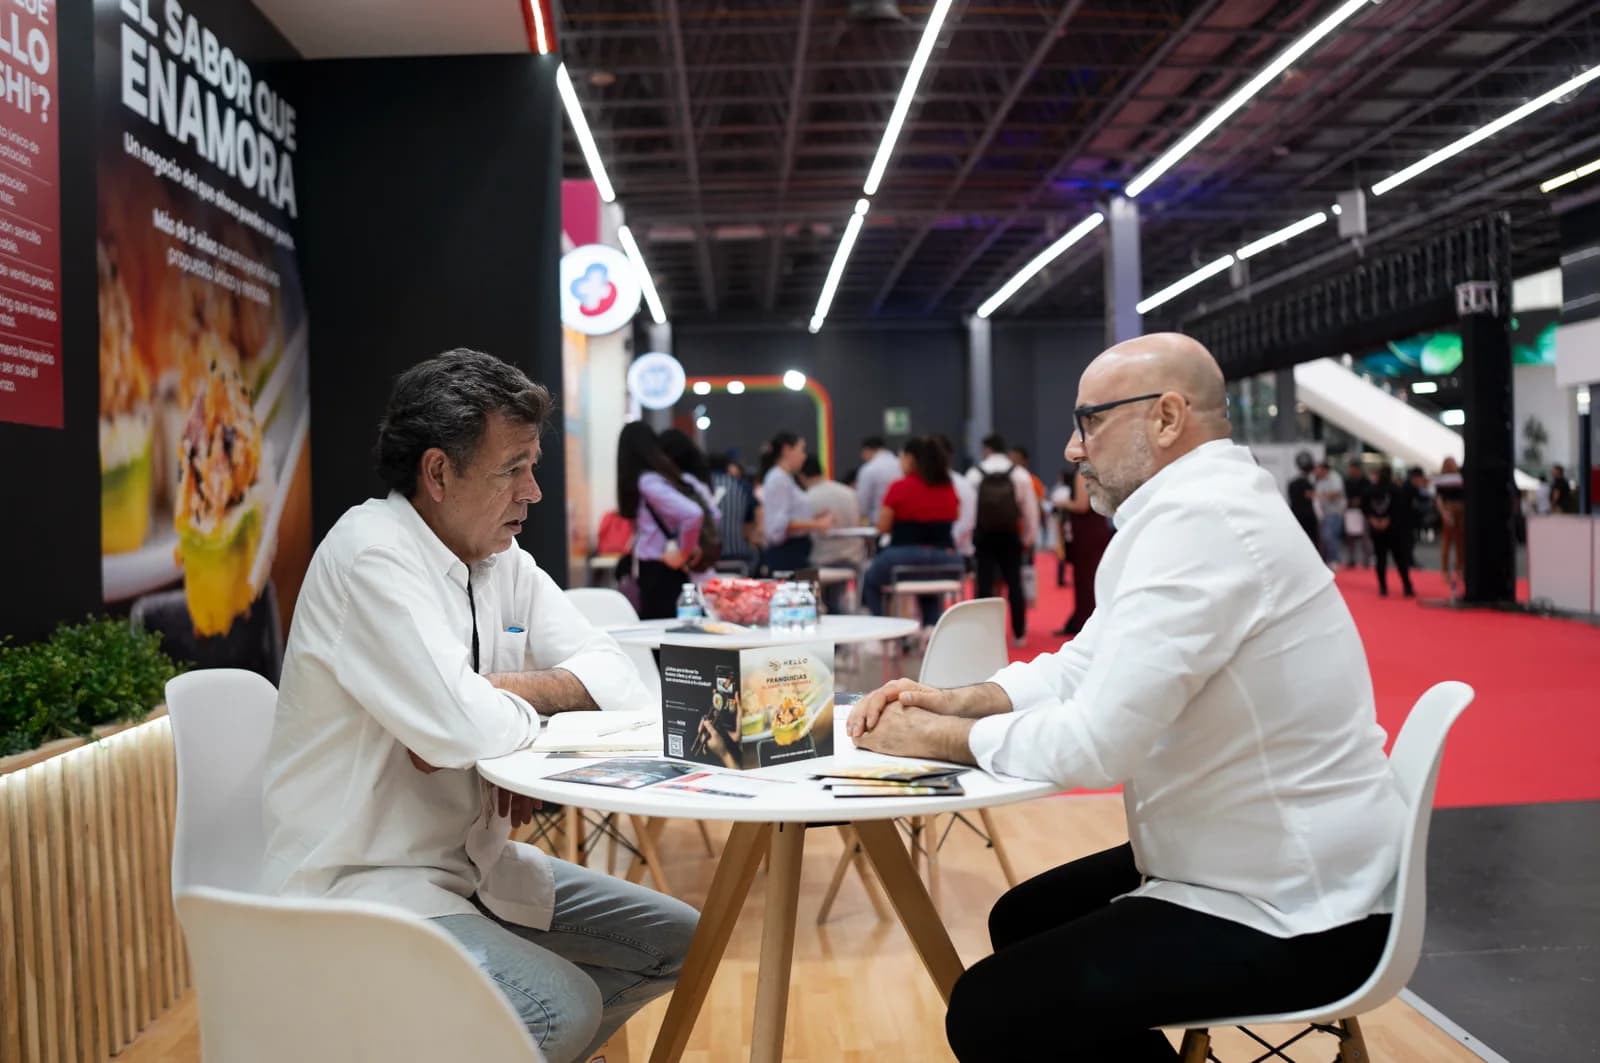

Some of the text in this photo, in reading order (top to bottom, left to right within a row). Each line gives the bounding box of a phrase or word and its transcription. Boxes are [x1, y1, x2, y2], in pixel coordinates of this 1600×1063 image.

[121, 23, 298, 218] ENAMORA
[164, 0, 253, 117] SABOR
[255, 80, 298, 152] QUE
[123, 131, 141, 159] Un
[141, 146, 183, 183] negocio
[153, 207, 175, 235] Más
[175, 219, 189, 242] de
